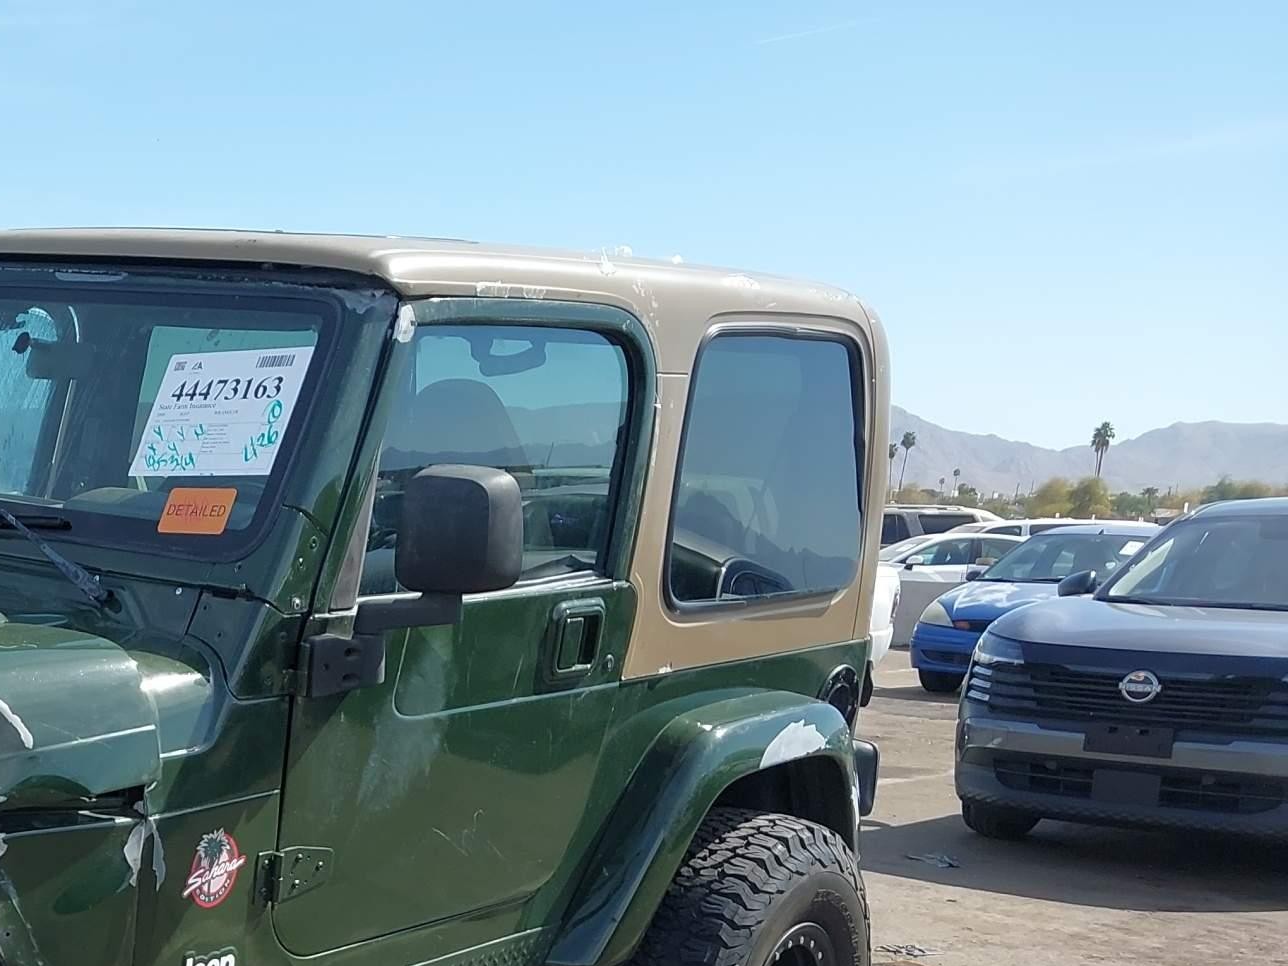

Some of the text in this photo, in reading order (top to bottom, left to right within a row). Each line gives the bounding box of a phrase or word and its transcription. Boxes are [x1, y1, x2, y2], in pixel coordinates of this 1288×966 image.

[170, 375, 285, 402] 44473163
[166, 503, 226, 518] DETAILED
[183, 855, 247, 898] Sahara
